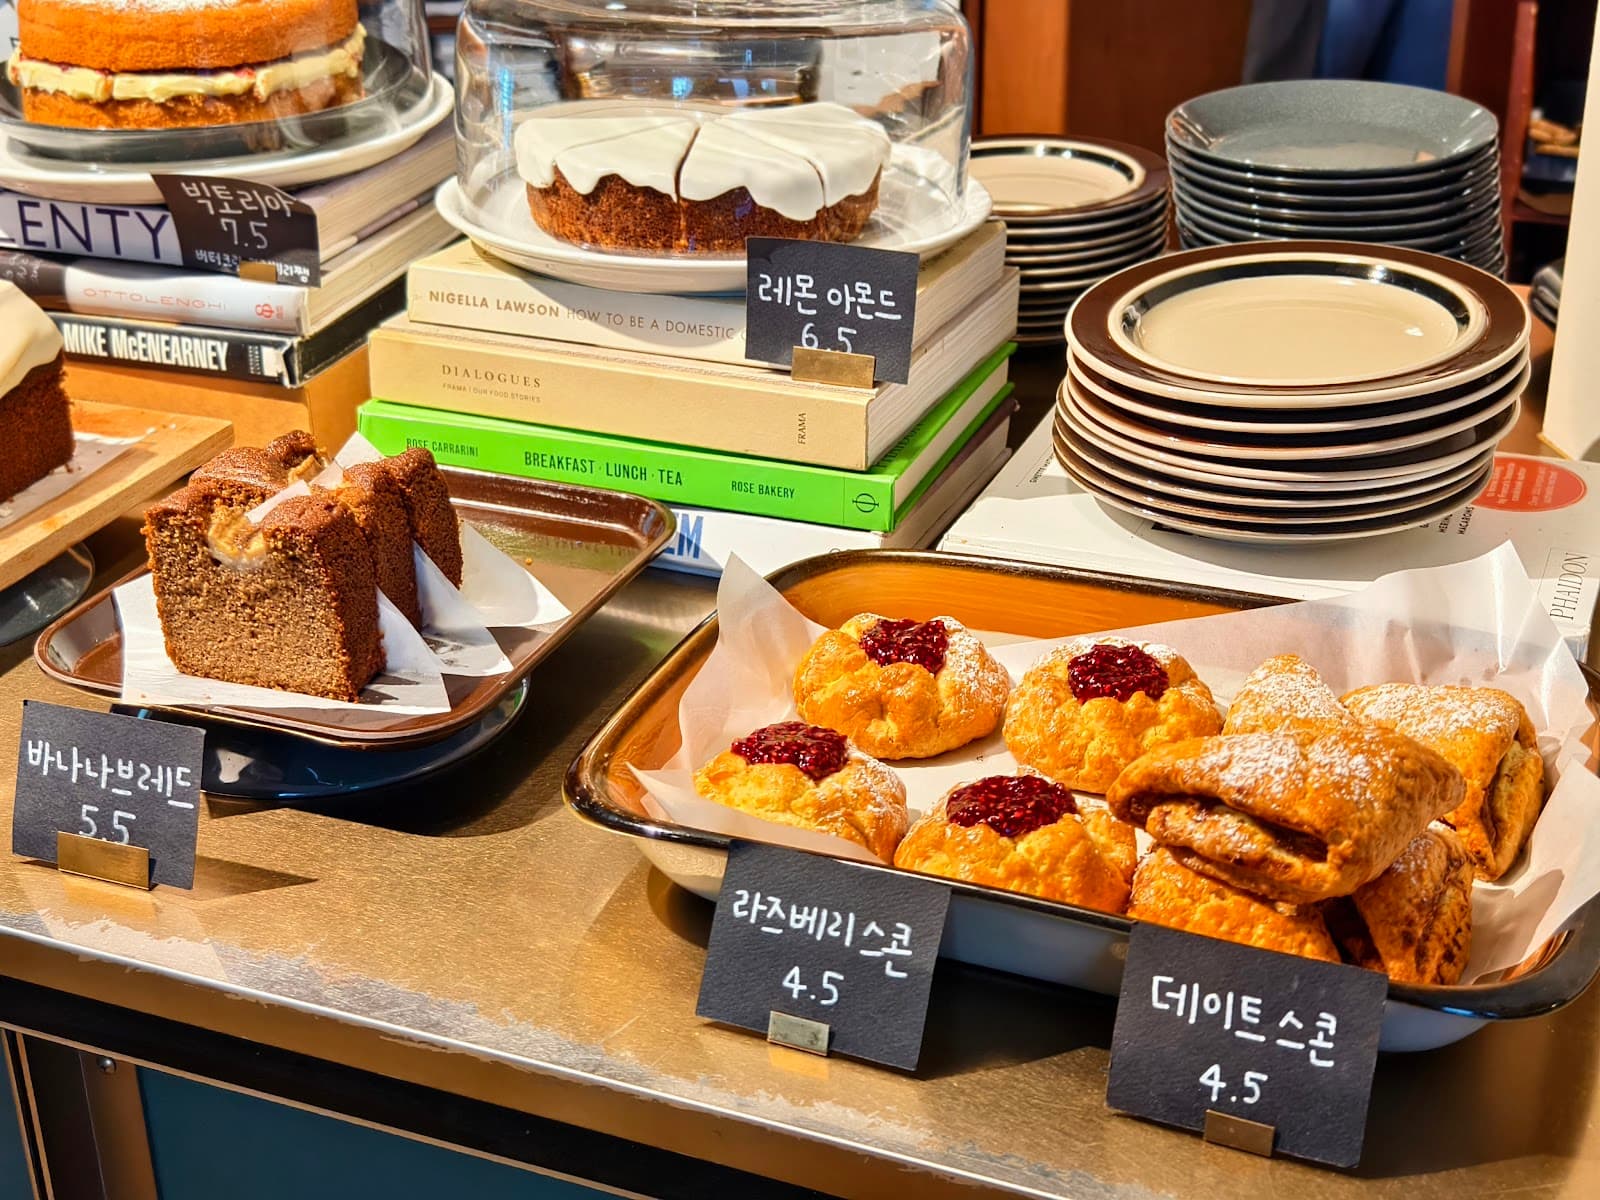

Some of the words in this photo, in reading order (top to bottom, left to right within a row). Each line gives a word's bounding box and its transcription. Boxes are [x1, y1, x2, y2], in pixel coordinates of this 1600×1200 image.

[180, 181, 294, 218] 빅토리아
[219, 217, 268, 250] 7.5
[84, 288, 227, 310] OTTOLENGHI
[429, 290, 489, 308] NIGELLA
[496, 299, 560, 317] LAWSON
[567, 308, 600, 322] HOW
[606, 312, 624, 326] TO
[629, 316, 644, 329] BE
[650, 320, 660, 331] A
[665, 320, 735, 339] DOMESTIC
[757, 273, 818, 315] 레몬
[826, 281, 902, 320] 아몬드
[62, 323, 109, 357] MIKE
[109, 327, 229, 371] McENEARNEY
[441, 364, 541, 388] DIALOGUES
[406, 438, 429, 451] ROSE
[432, 442, 479, 457] CARRARINI
[797, 412, 807, 445] FRAMA
[524, 451, 595, 475] BREAKFAST
[605, 463, 648, 481] LUNCH
[658, 469, 683, 487] TEA
[731, 480, 756, 494] ROSE
[758, 484, 795, 499] BAKERY
[1549, 552, 1589, 620] PHAIDON
[27, 740, 195, 809] 바나나브레드
[782, 966, 844, 1006] 4.5
[1151, 975, 1266, 1042] 데이트
[1276, 1010, 1338, 1068] 스콘
[1199, 1063, 1269, 1104] 4.5
